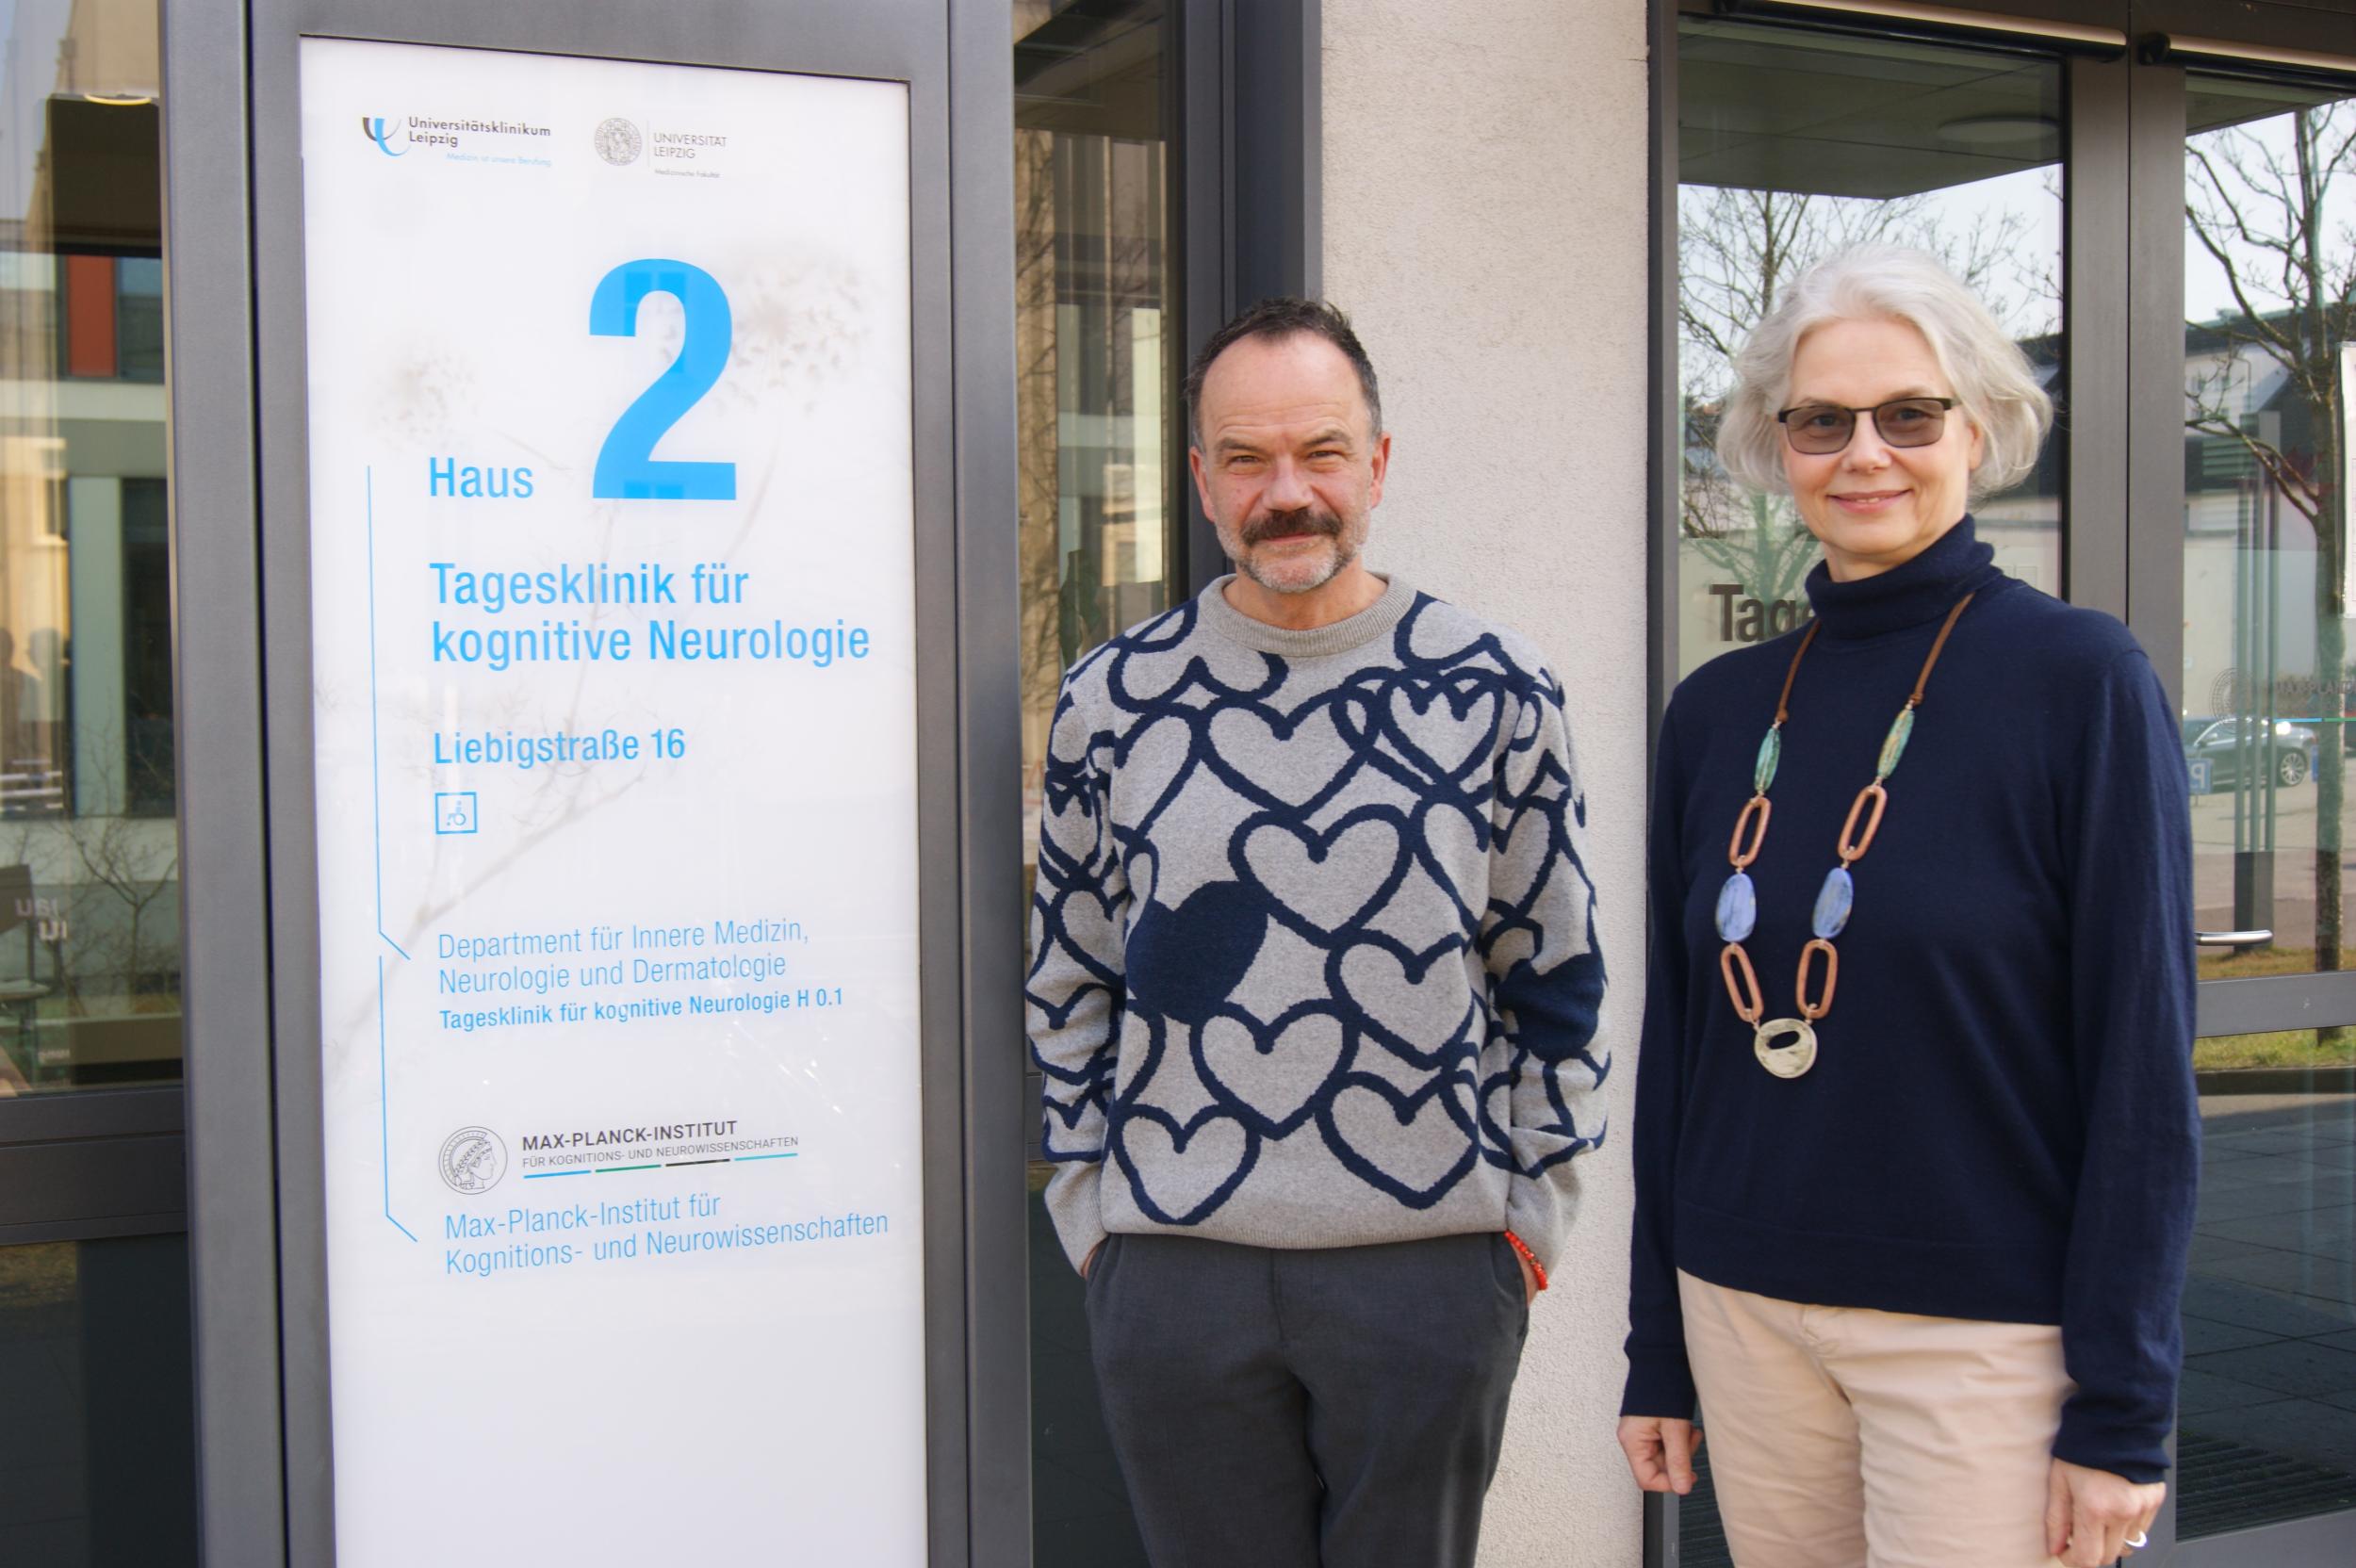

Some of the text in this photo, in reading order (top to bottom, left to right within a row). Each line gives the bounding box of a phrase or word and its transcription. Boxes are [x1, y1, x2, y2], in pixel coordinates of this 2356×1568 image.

[409, 116, 550, 136] Universitätsklinikum
[409, 131, 457, 148] Leipzig
[654, 147, 695, 158] LEIPZIG
[431, 259, 736, 499] Haus 2
[430, 564, 748, 613] Tagesklinik für
[434, 620, 868, 671] kognitive Neurologie
[434, 729, 684, 769] Liebigstraße 16
[439, 918, 810, 962] Department für Innere Medizin,
[440, 954, 785, 994] Neurologie und Dermatologie
[440, 988, 843, 1032] Tagesklinik für kognitive Neurologie H 0.1
[521, 1119, 738, 1152] MAX-PLANCK-INSTITUT
[523, 1135, 799, 1168] FÜR KOGNITIONS- UND NEUROWISSENSCHAFTEN
[446, 1193, 720, 1240] Max-Planck-Institut für
[447, 1210, 888, 1277] Kognitions- und Neurowissenschaften
